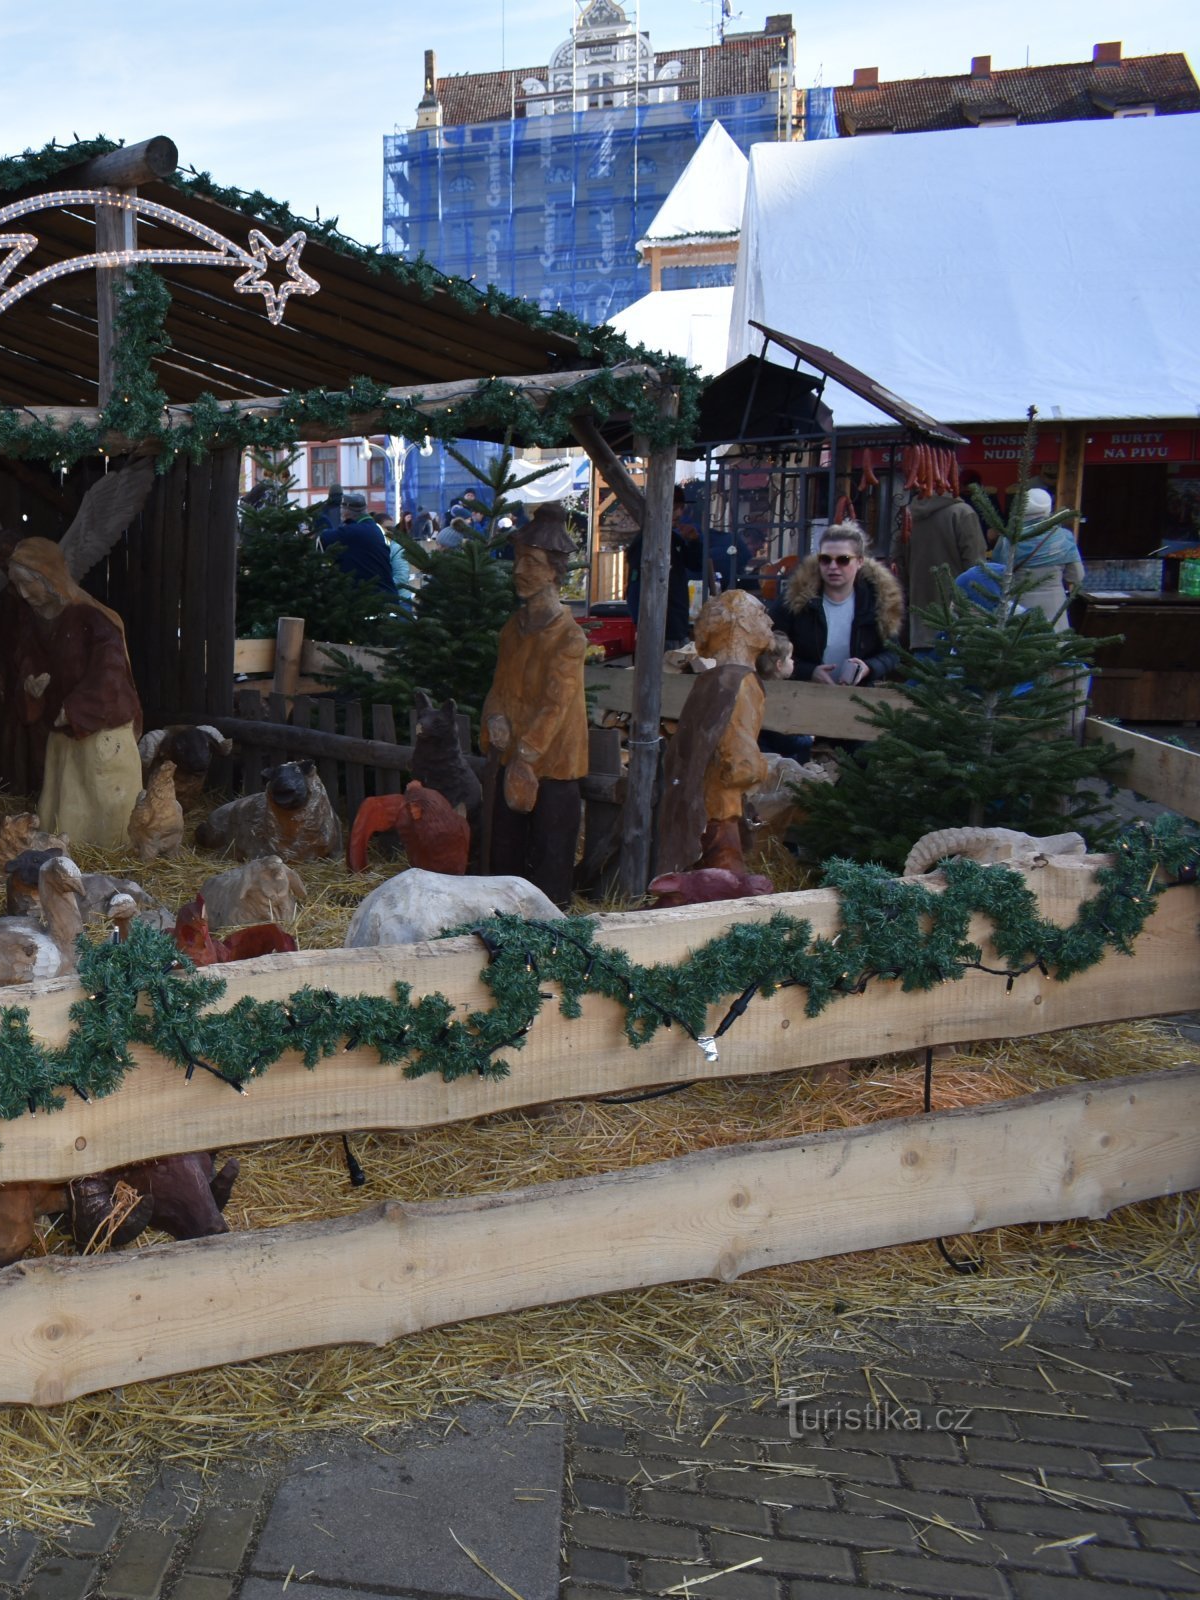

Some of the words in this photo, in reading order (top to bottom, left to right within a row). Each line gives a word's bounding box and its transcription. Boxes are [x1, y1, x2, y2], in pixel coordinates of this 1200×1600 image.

[540, 202, 556, 267] Cemix
[596, 208, 616, 274] Cemix
[1103, 447, 1127, 459] NA
[1131, 447, 1169, 458] PIVU
